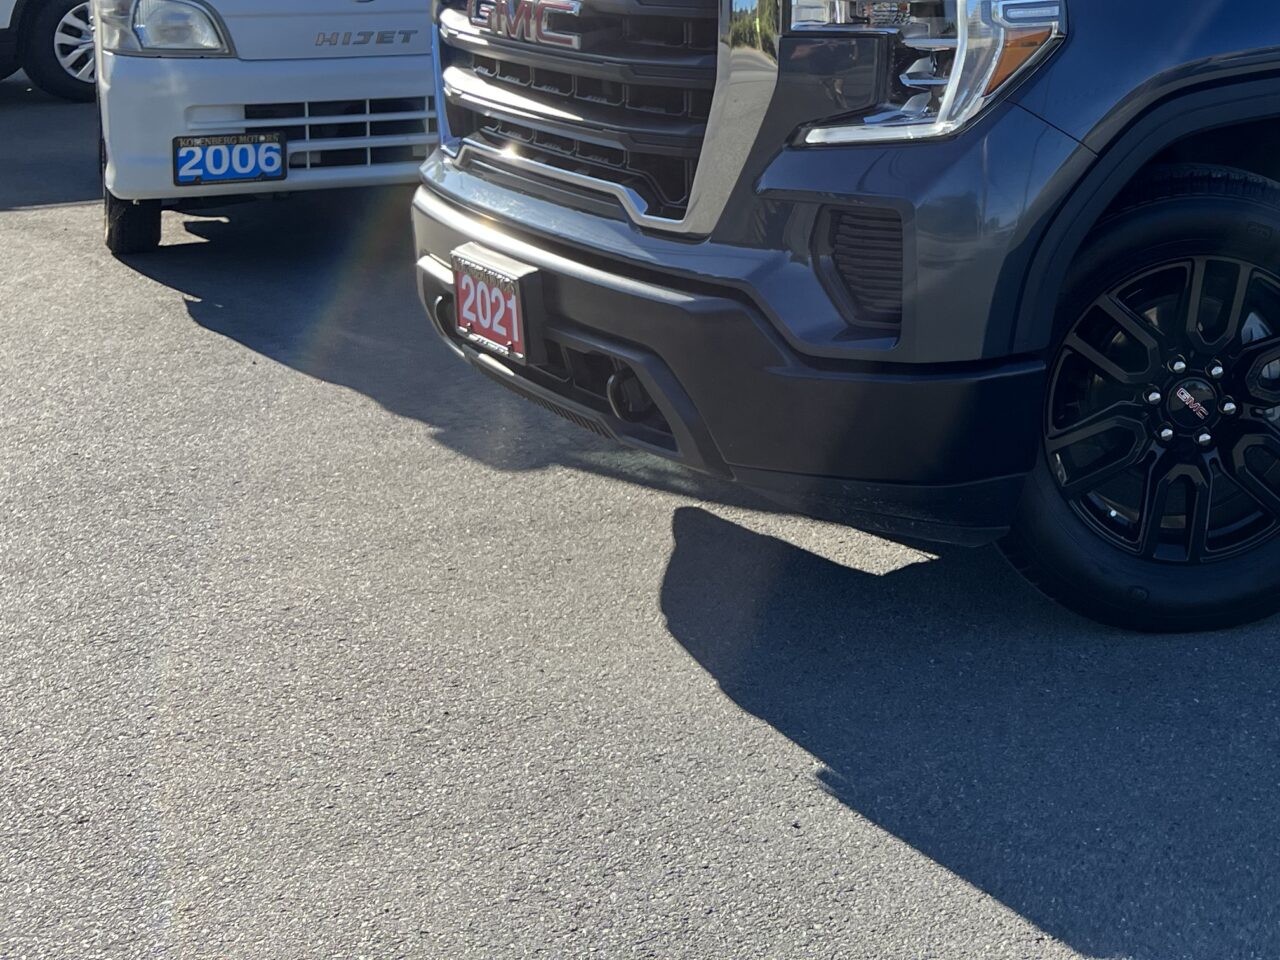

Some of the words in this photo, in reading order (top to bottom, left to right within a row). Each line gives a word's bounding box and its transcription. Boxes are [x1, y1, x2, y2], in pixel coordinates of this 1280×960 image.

[314, 29, 418, 46] HIJET
[180, 135, 238, 147] KOENBERG
[239, 133, 279, 144] MOTRS
[178, 143, 282, 176] 2006
[461, 274, 519, 342] 2021
[1176, 387, 1209, 420] GMC
